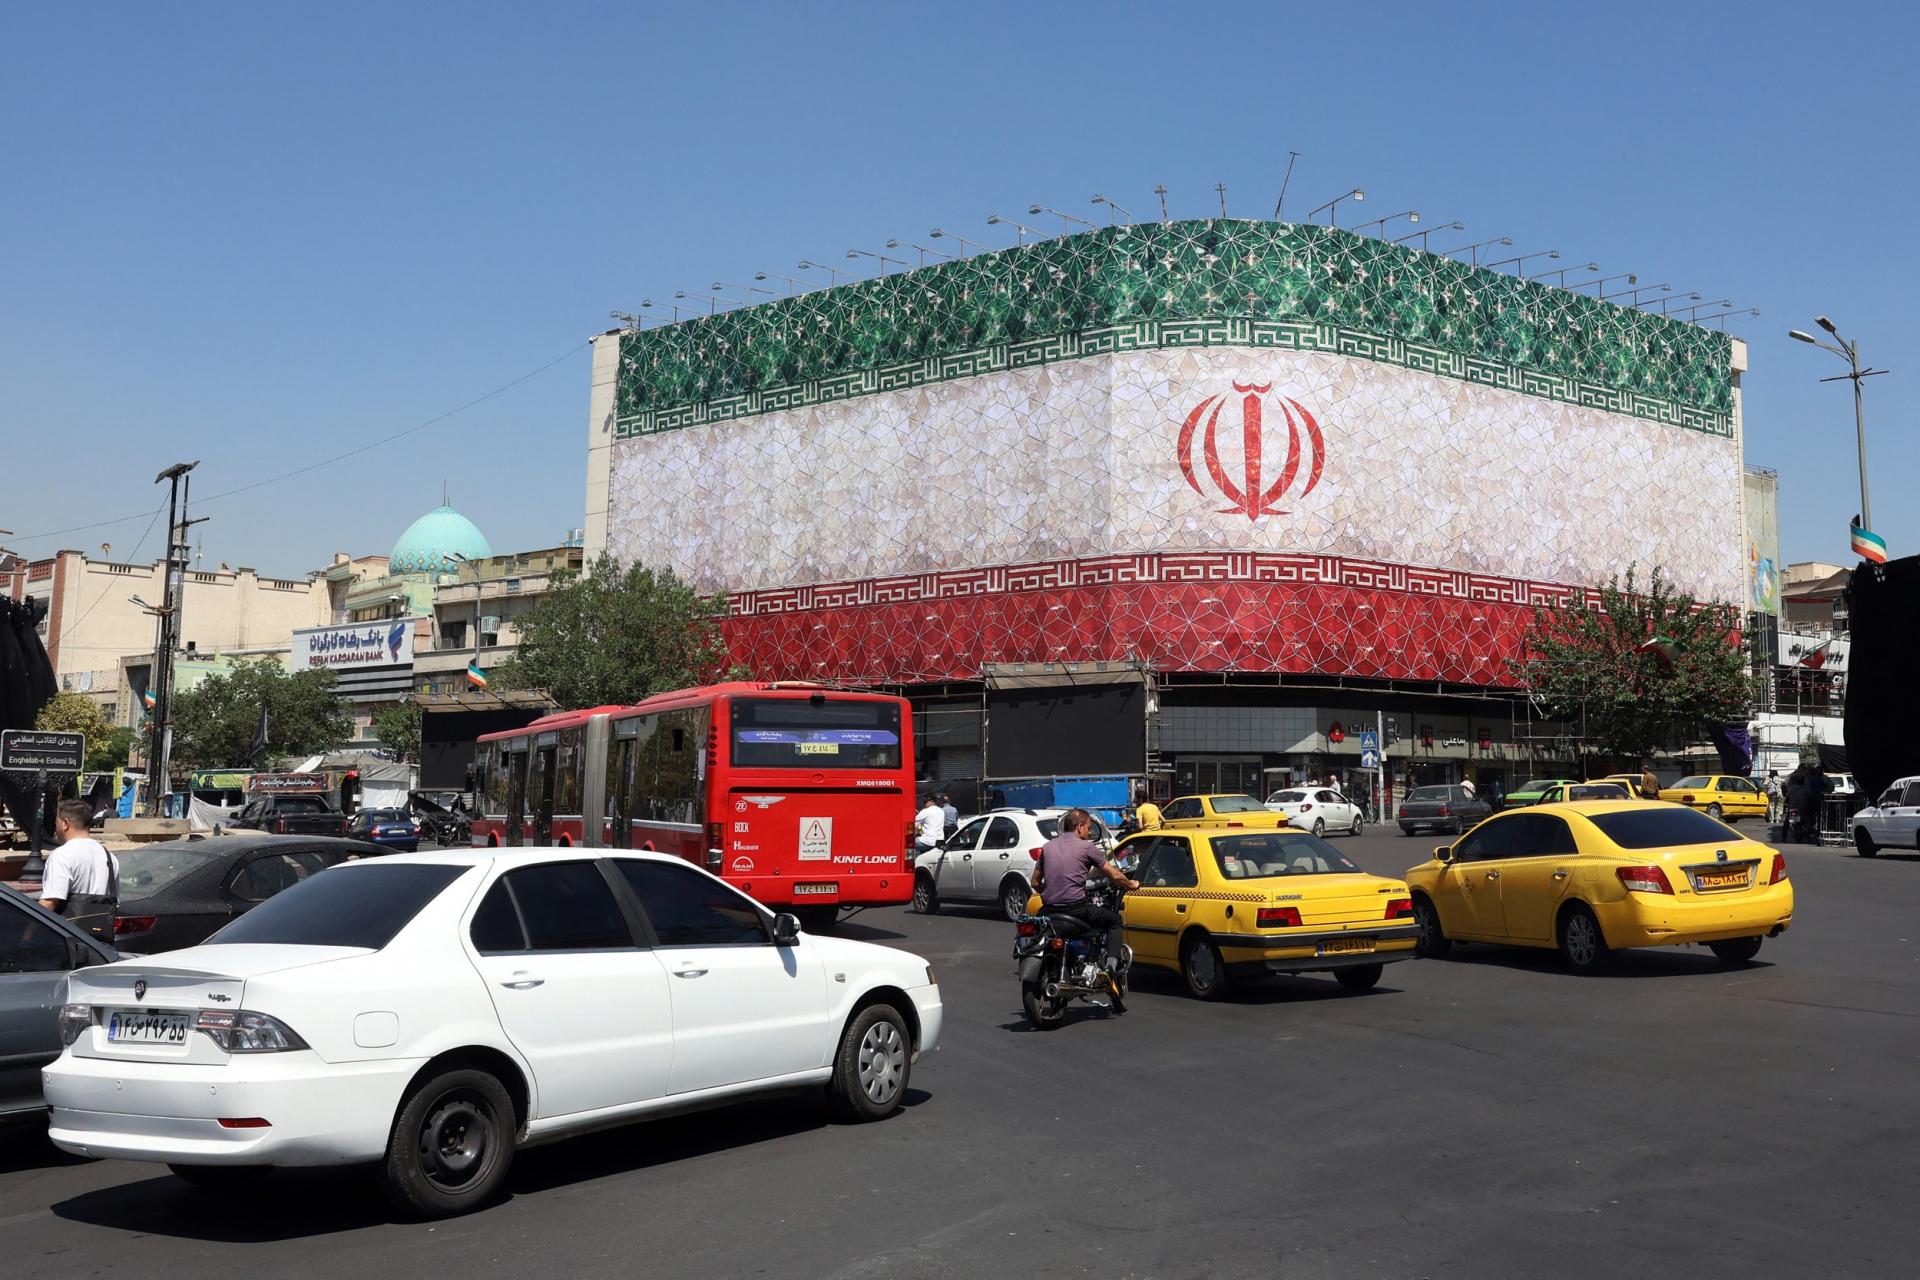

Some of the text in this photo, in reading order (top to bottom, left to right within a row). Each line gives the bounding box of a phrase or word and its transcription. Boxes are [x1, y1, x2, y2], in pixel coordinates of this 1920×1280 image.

[309, 628, 384, 653] بانک رفاه کارگران
[366, 650, 384, 662] BANK
[10, 735, 77, 748] میدان انقلاب اسلامی
[1443, 737, 1466, 746] ساعتی
[46, 757, 67, 765] Eslami
[833, 856, 898, 864] KING LONG
